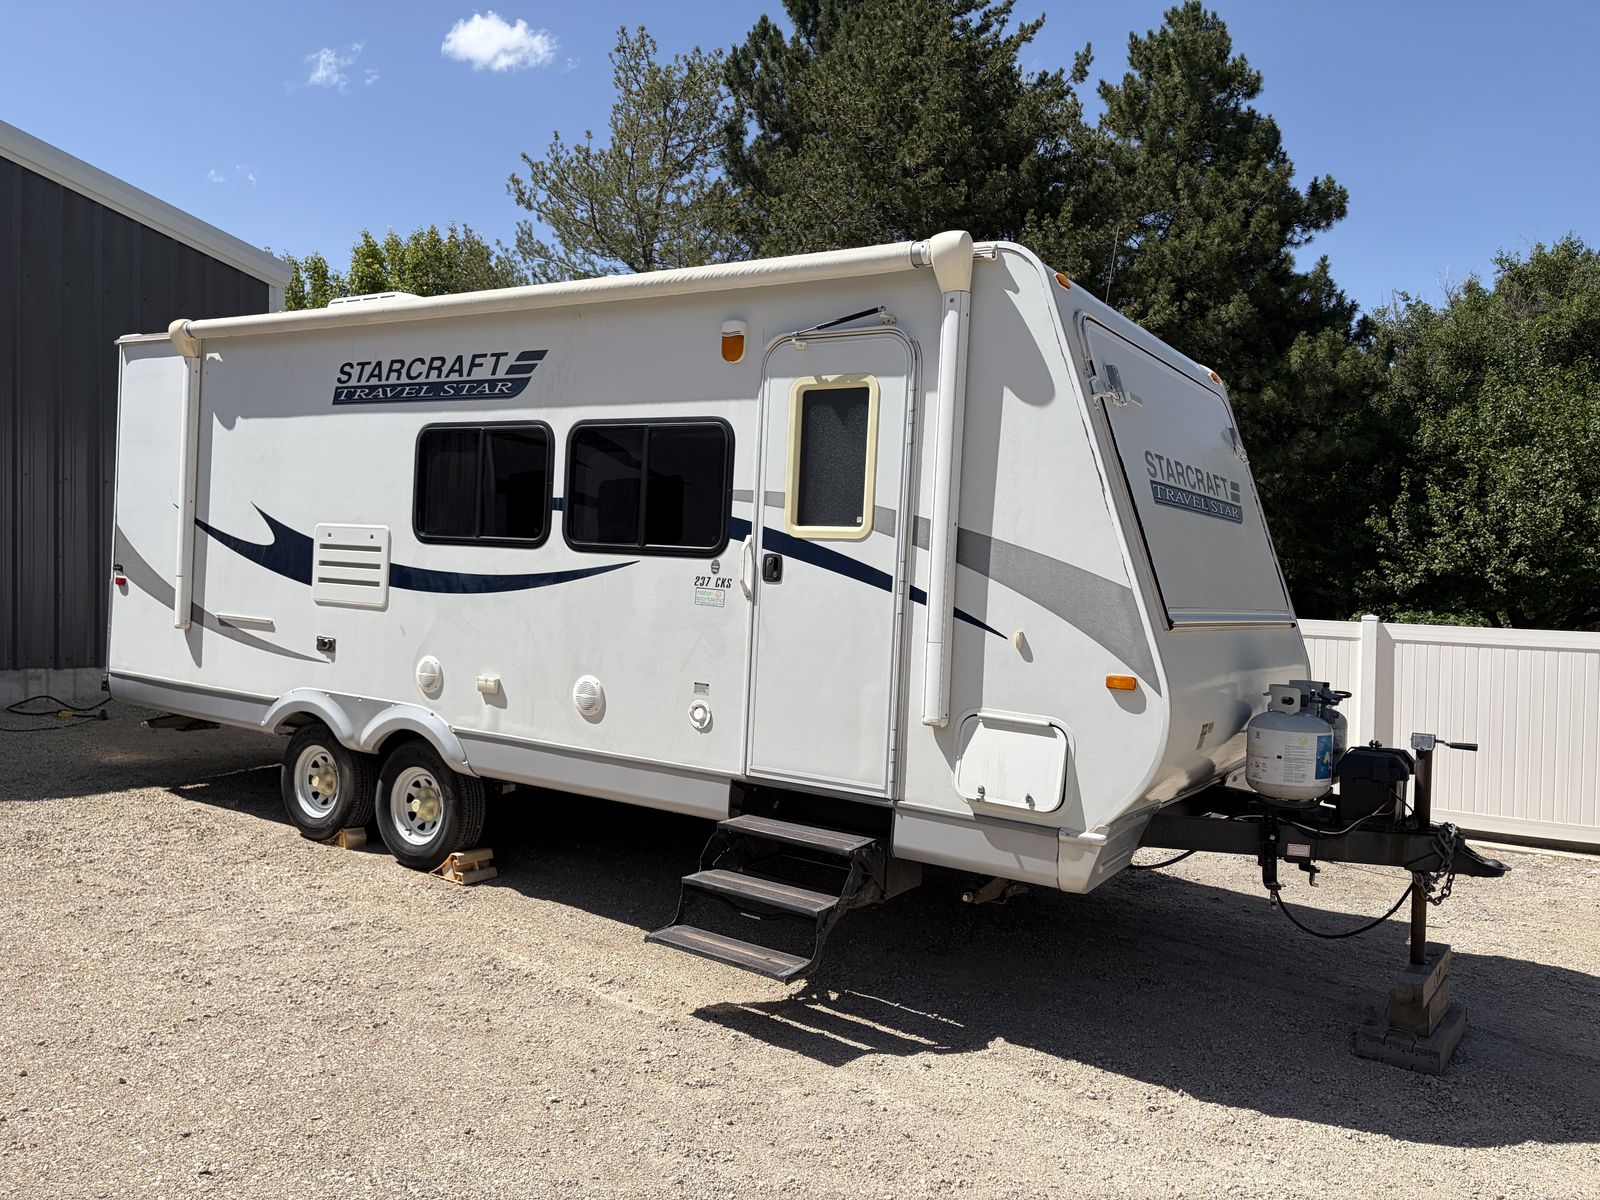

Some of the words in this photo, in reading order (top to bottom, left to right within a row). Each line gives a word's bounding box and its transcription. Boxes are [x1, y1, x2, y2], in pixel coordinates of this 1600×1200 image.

[336, 351, 509, 385] STARCRAFT
[337, 385, 434, 401] TRAVEL
[440, 381, 513, 397] STAR
[1144, 450, 1229, 500] STARCRAFT
[1152, 484, 1209, 511] TRAVEL
[1211, 500, 1239, 519] STAR
[694, 576, 711, 587] 237
[715, 577, 732, 588] CKS
